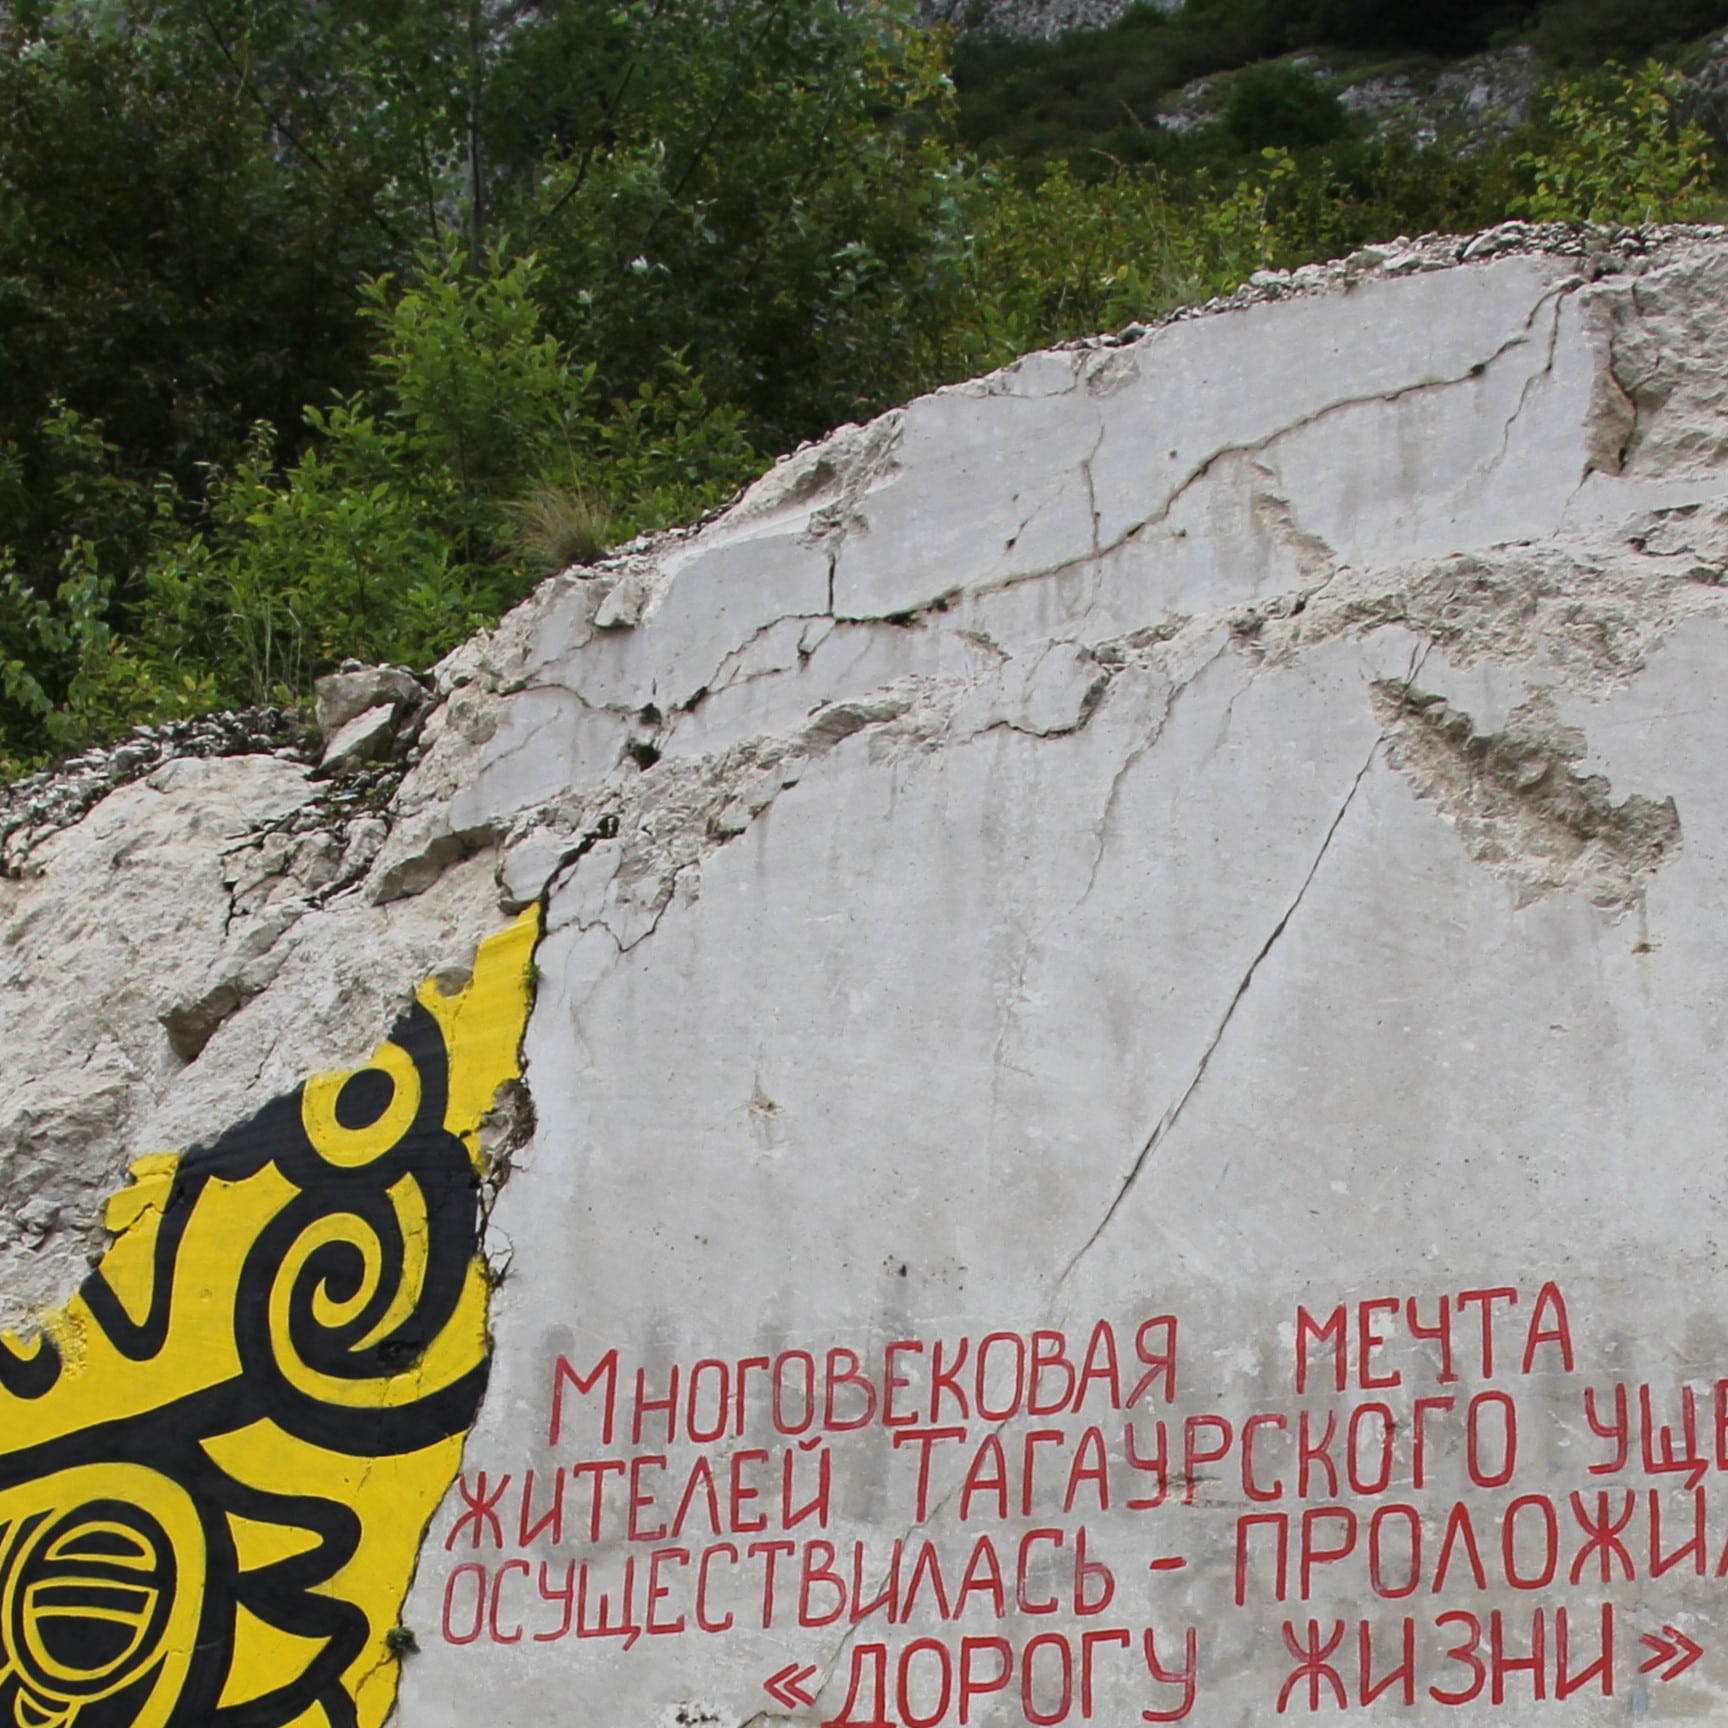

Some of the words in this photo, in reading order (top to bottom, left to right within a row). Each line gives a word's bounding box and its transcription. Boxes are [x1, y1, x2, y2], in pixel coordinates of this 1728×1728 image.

[547, 1313, 1179, 1448] МНОГОВЕКОВАЯ
[1294, 1281, 1575, 1396] МЕЧТА
[444, 1435, 833, 1552] ЖИТЕЛЕЙ
[891, 1388, 1518, 1525] ТАГАУРСКОГО
[441, 1526, 1117, 1652] ОСУЩЕСТВИЛАСЬ
[1275, 1601, 1706, 1714] ЖИЗНИ»
